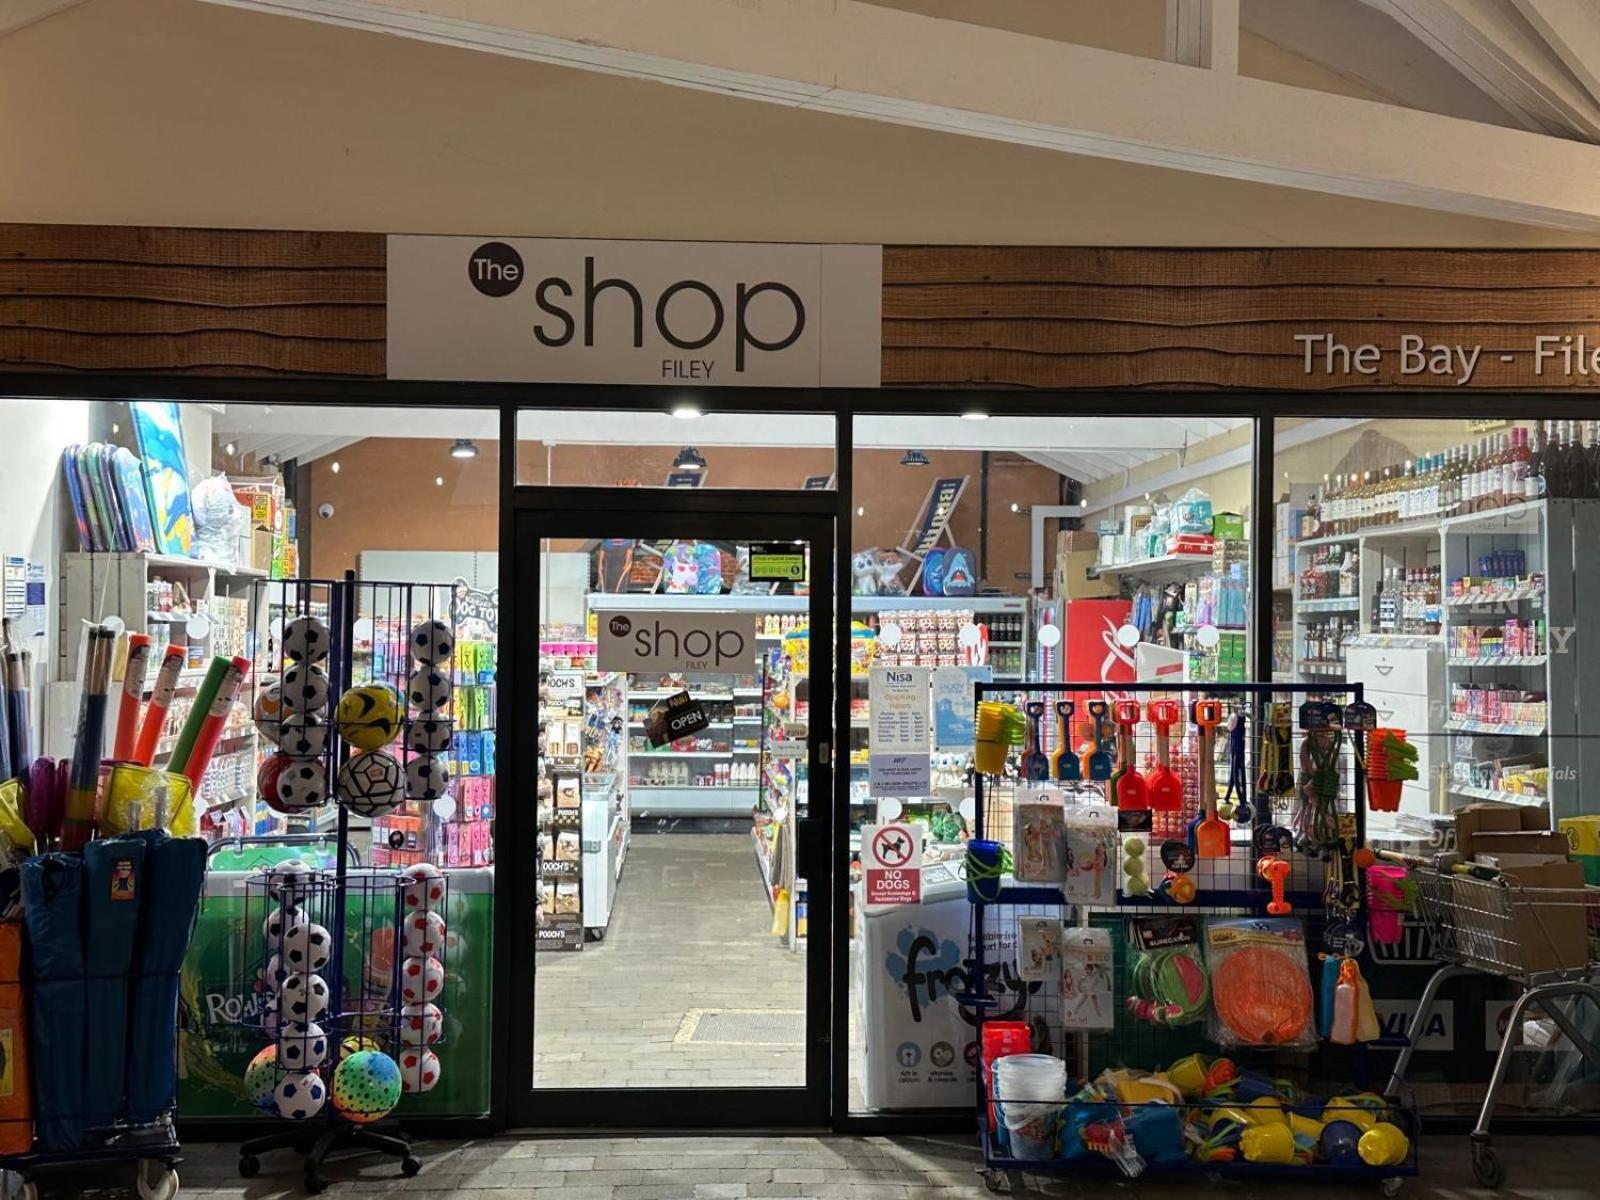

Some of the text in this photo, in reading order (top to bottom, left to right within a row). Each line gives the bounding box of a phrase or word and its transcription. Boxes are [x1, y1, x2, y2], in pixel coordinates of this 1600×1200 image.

[473, 257, 519, 281] The
[533, 256, 806, 373] shop
[662, 359, 715, 379] FILEY
[1293, 333, 1381, 374] The
[1400, 334, 1482, 386] Bay
[611, 621, 630, 632] The
[634, 620, 745, 667] shop
[886, 671, 913, 682] Nisa
[671, 710, 703, 730] OPEN
[543, 861, 569, 871] OOCH'S
[884, 869, 902, 880] NO
[876, 879, 910, 890] DOGS
